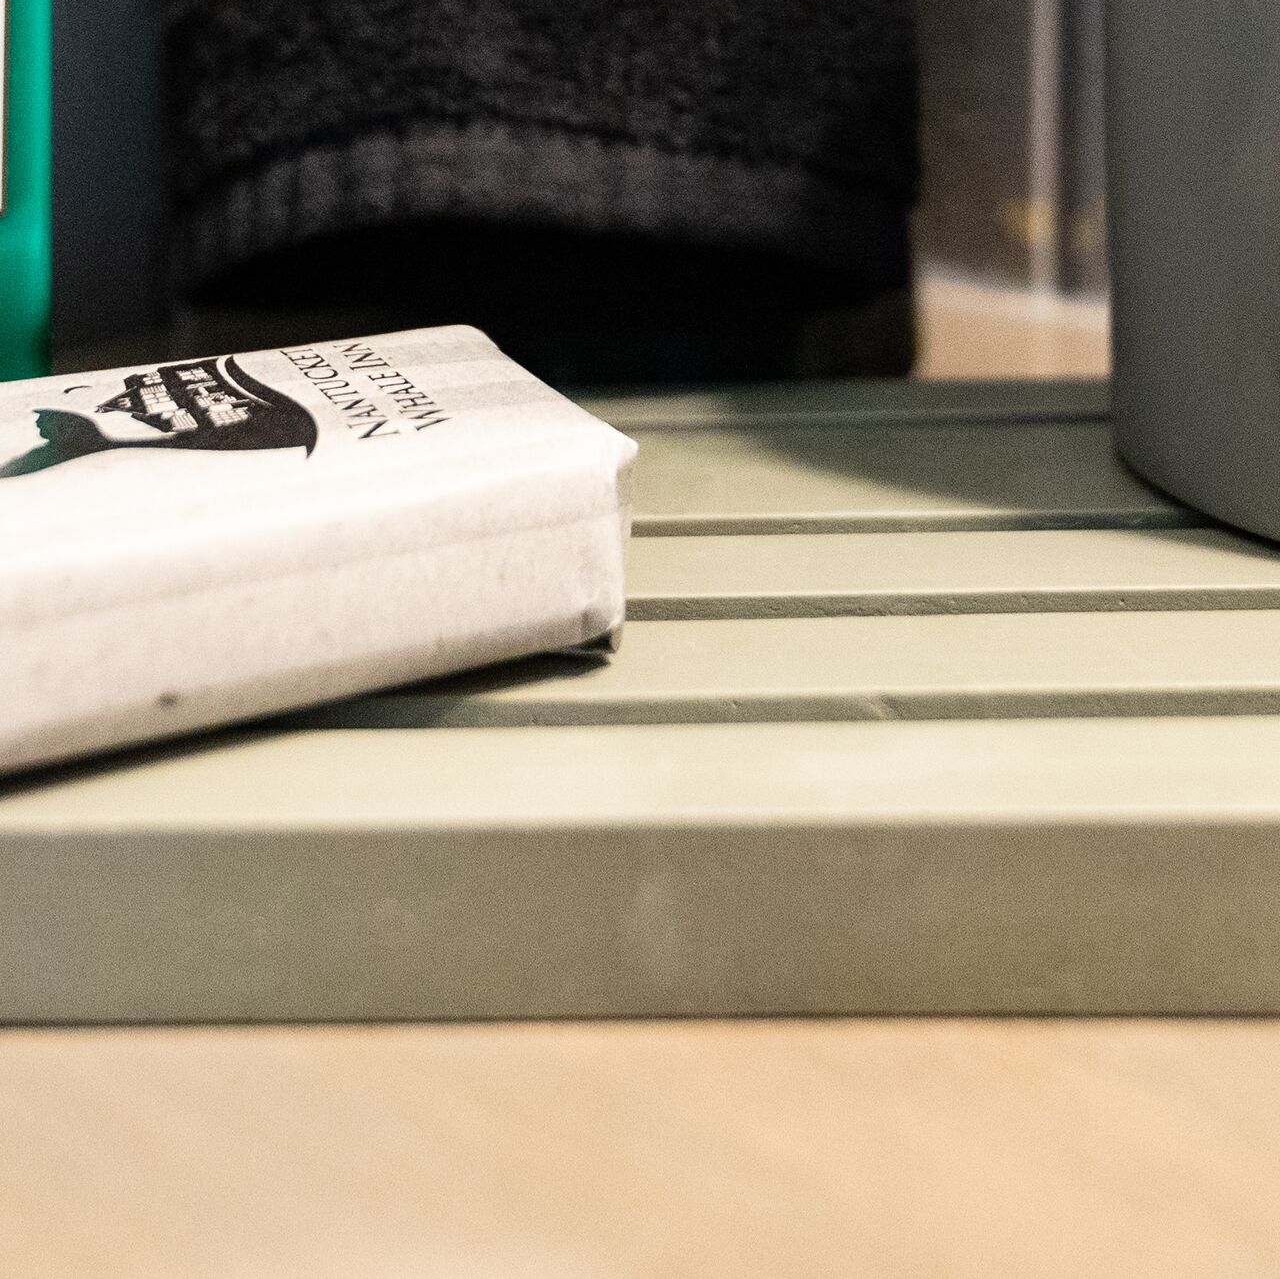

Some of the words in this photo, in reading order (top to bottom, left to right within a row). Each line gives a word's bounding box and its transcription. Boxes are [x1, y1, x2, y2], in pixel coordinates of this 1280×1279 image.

[333, 342, 391, 371] INN
[280, 348, 401, 440] NANTUCKET
[367, 370, 453, 431] WHALE
